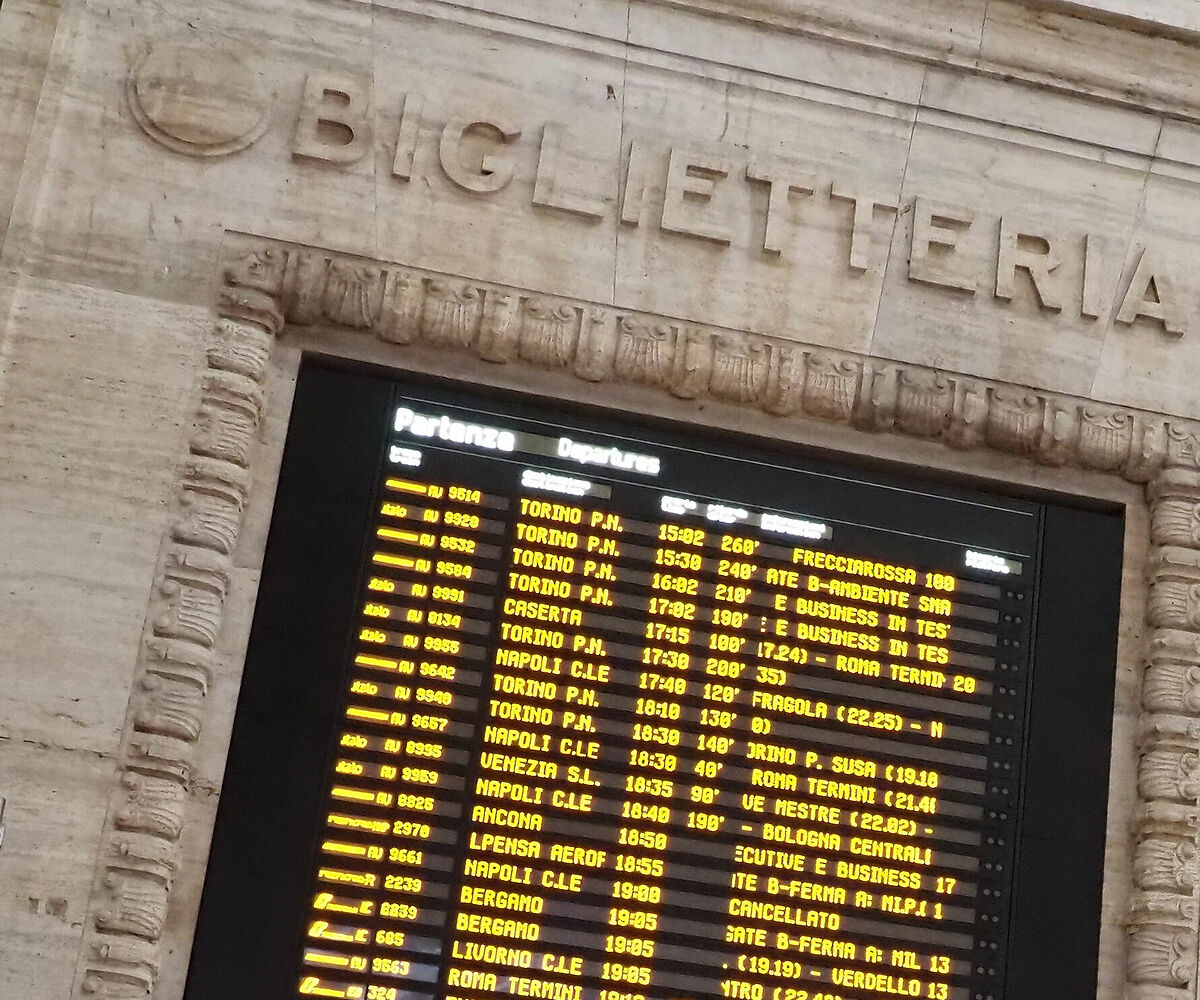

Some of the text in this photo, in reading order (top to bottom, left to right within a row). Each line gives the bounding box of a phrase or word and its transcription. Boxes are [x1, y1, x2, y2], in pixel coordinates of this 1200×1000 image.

[291, 69, 1184, 340] BIGLIETTERIA
[516, 522, 578, 549] TORINO
[586, 535, 620, 557] P.N.
[655, 547, 702, 571] 15:30
[717, 559, 757, 580] 240'
[807, 574, 910, 608] B-AMBIENTE
[520, 498, 582, 524] TORINO
[590, 510, 623, 532] P.N.
[657, 523, 705, 547] 15:02
[720, 534, 760, 555] 260'
[792, 547, 916, 585] FRECCIAROSSA
[508, 571, 571, 598] TORINO
[579, 584, 613, 606] P.N.
[648, 596, 695, 620] 17:02
[711, 608, 748, 628] 190'
[774, 618, 788, 636] E
[796, 622, 880, 652] BUSINESS
[888, 638, 908, 657] IN
[512, 547, 907, 632] TORINO P.N. 16:02 210' E BUSINESS IN
[500, 622, 564, 648] TORINO
[572, 634, 606, 656] P.N.
[641, 646, 690, 670] 17:30
[705, 657, 745, 678] 200'
[503, 597, 976, 693] CASERTA 17:15 100' ROMA 20
[493, 673, 557, 700] TORINO
[565, 685, 599, 707] P.N.
[635, 697, 680, 720] 18:10
[699, 708, 737, 728] 130'
[495, 647, 562, 674] NAPOLI
[570, 660, 610, 683] C.LE
[638, 672, 686, 695] 17:40
[702, 682, 740, 703] 120'
[835, 705, 903, 731] (22.25)
[483, 725, 876, 804] NAPOLI C.LE 18:30 40' ROMA TERMINI
[489, 699, 876, 778] TORINO P.N. 18:30 140' P. SUSA
[475, 777, 841, 851] NAPOLI C.LE 18:40 190' BOLOGNA
[479, 751, 558, 779] VENEZIA
[566, 765, 601, 786] S.L.
[625, 775, 673, 797] 18:35
[690, 785, 720, 804] 90'
[774, 798, 840, 824] MESTRE
[849, 810, 917, 836] (22.02)
[471, 805, 543, 831] ANCONA
[618, 827, 667, 850] 18:50
[814, 857, 827, 875] E
[836, 860, 921, 889] BUSINESS
[935, 876, 956, 894] 17
[614, 853, 664, 877] 18:55
[766, 876, 846, 904] B-FERMA
[854, 890, 872, 908] A:
[933, 902, 942, 919] 1
[459, 885, 543, 914] BERGAMO
[607, 907, 658, 931] 19:05
[776, 931, 856, 960] B-FERMA
[864, 945, 883, 963] A:
[929, 955, 950, 974] 13
[463, 858, 532, 884] NAPOLI
[540, 869, 582, 892] C.LE
[611, 880, 661, 904] 19:00
[728, 897, 840, 930] CANCELLATO
[447, 967, 497, 991] ROMA
[451, 940, 532, 968] LIVORNO
[540, 953, 583, 975] C.LE
[601, 961, 651, 985] 19:05
[455, 912, 948, 1000] BERGAMO 19:05 (19.19) VERDELLO 13
